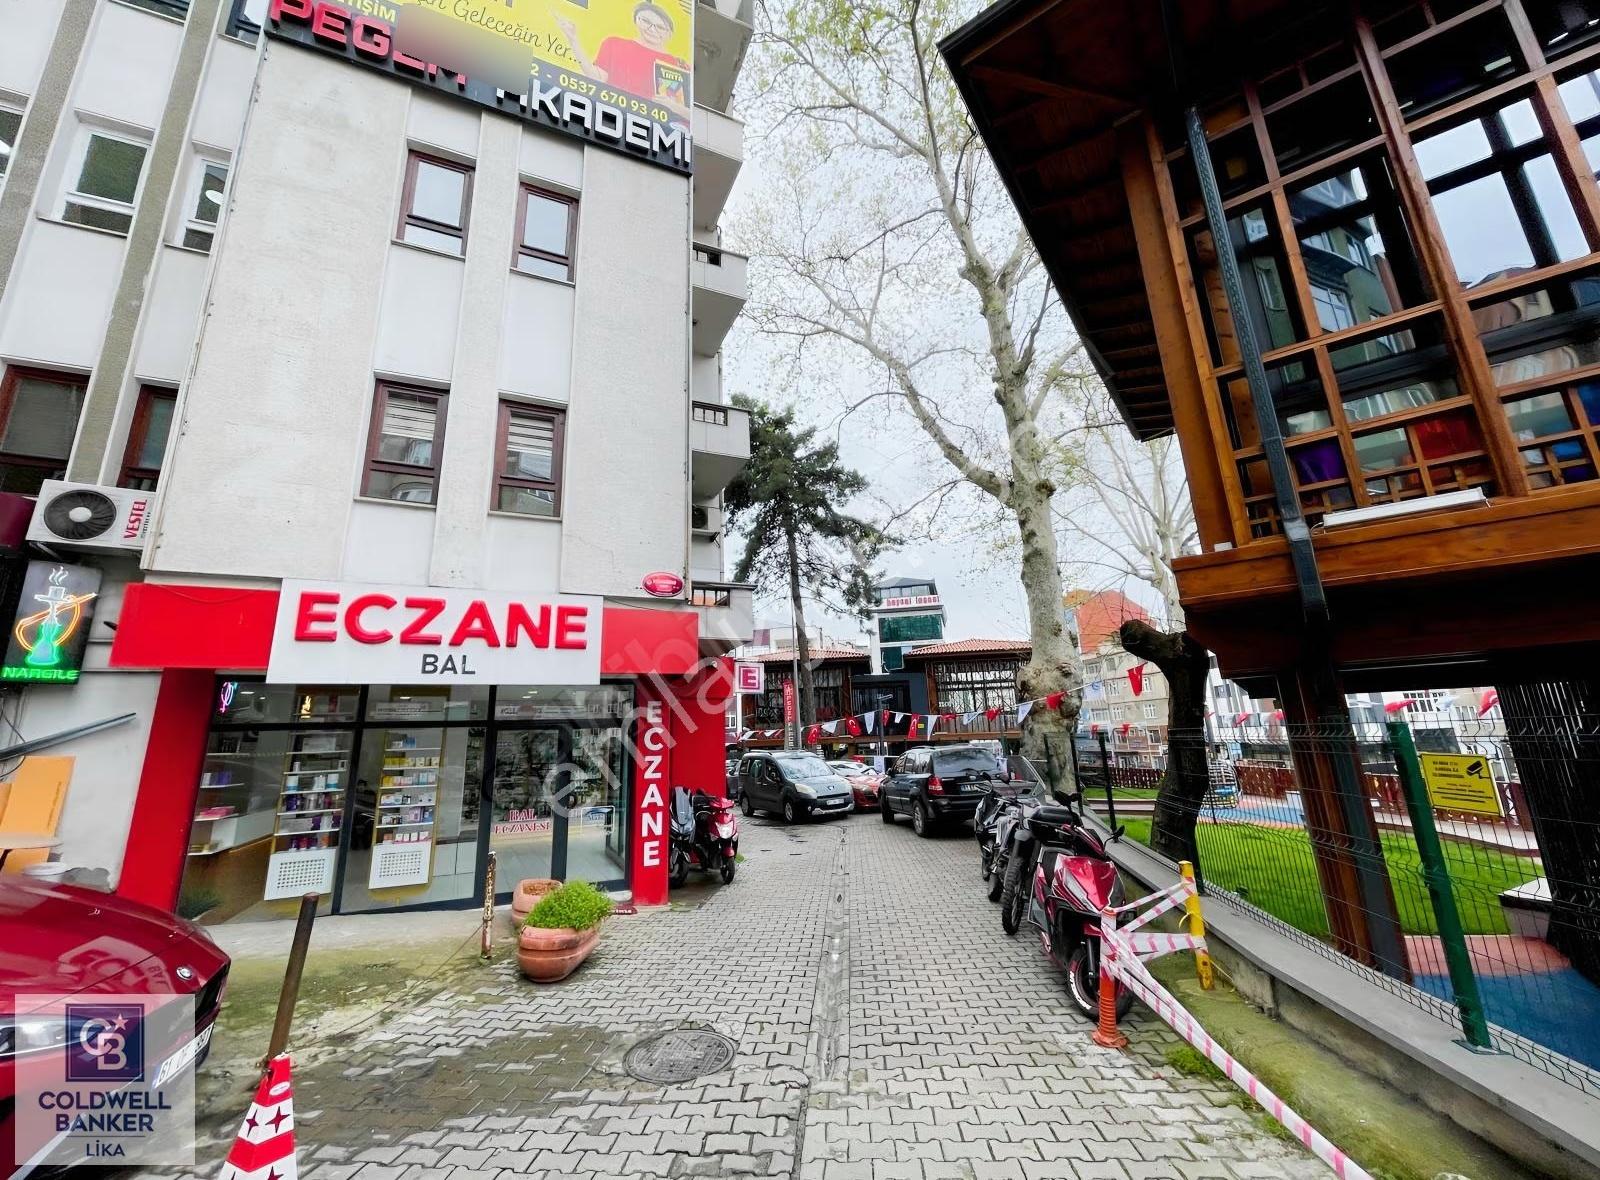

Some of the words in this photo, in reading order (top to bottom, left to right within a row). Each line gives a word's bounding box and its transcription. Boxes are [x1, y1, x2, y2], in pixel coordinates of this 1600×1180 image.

[453, 0, 541, 48] Geleceğin
[559, 73, 597, 95] 0537
[600, 89, 628, 108] 670
[631, 100, 648, 116] 93
[651, 108, 668, 123] 40
[123, 499, 148, 539] VESTEL
[294, 591, 588, 650] ECZANE
[421, 653, 477, 675] BAL
[741, 668, 758, 687] E
[641, 700, 664, 867] ECZANE
[508, 808, 537, 822] BAL
